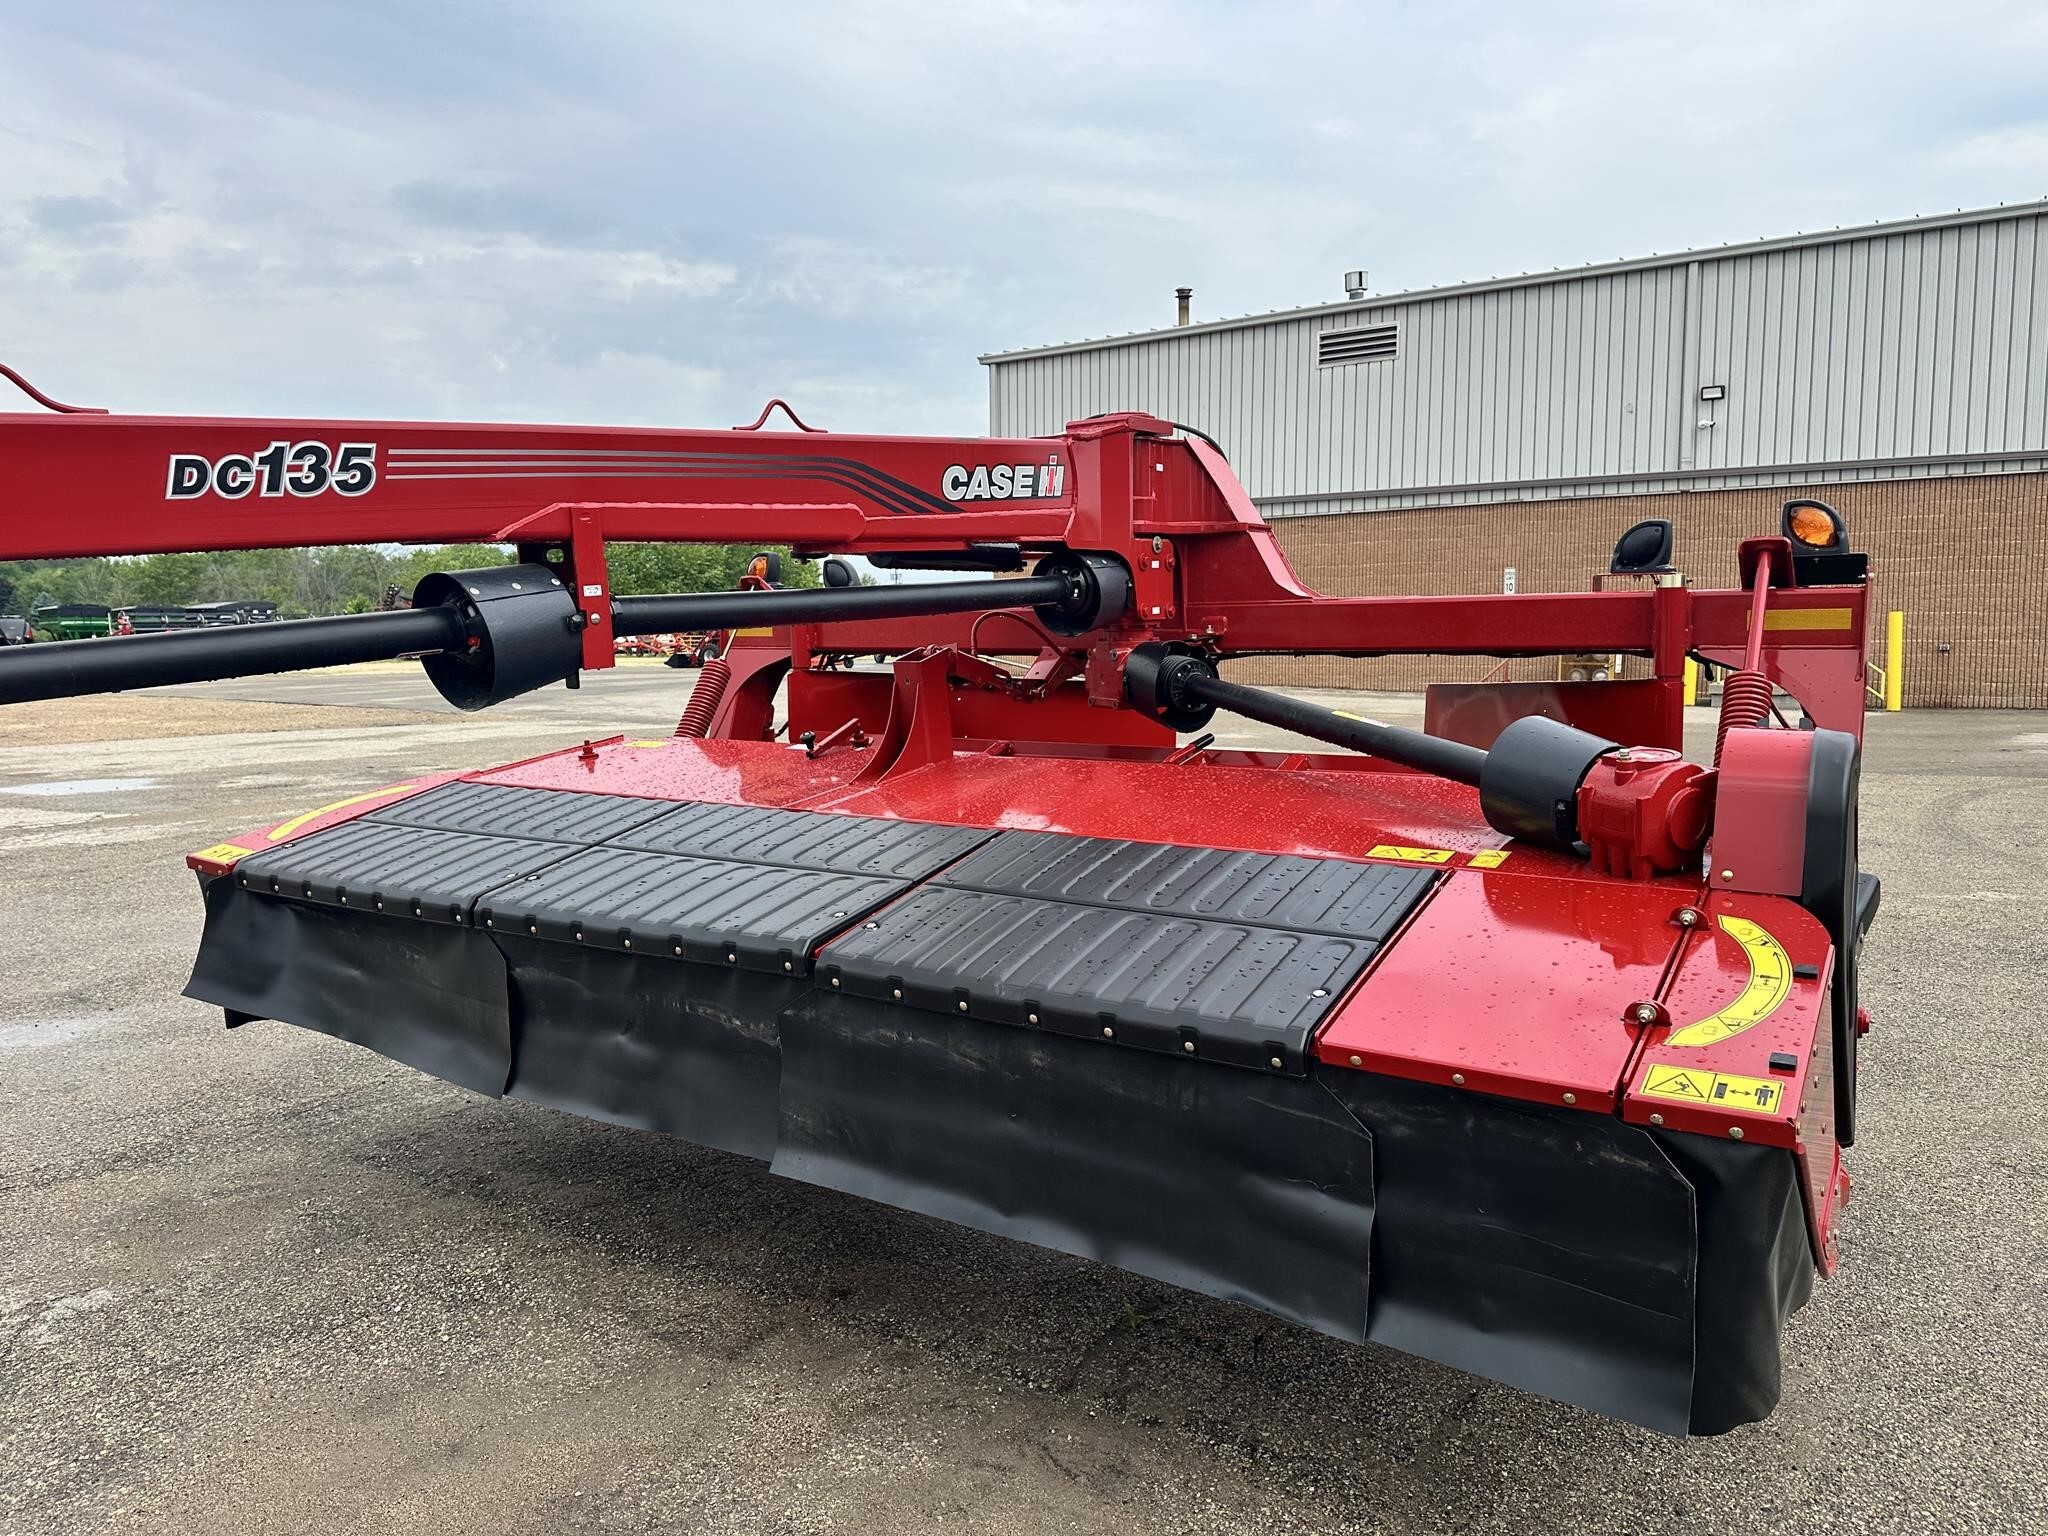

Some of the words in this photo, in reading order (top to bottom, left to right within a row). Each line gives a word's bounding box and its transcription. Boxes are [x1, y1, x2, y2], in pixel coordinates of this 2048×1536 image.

[165, 440, 377, 500] DC135
[942, 464, 1035, 501] CASE
[1505, 582, 1514, 592] 10
